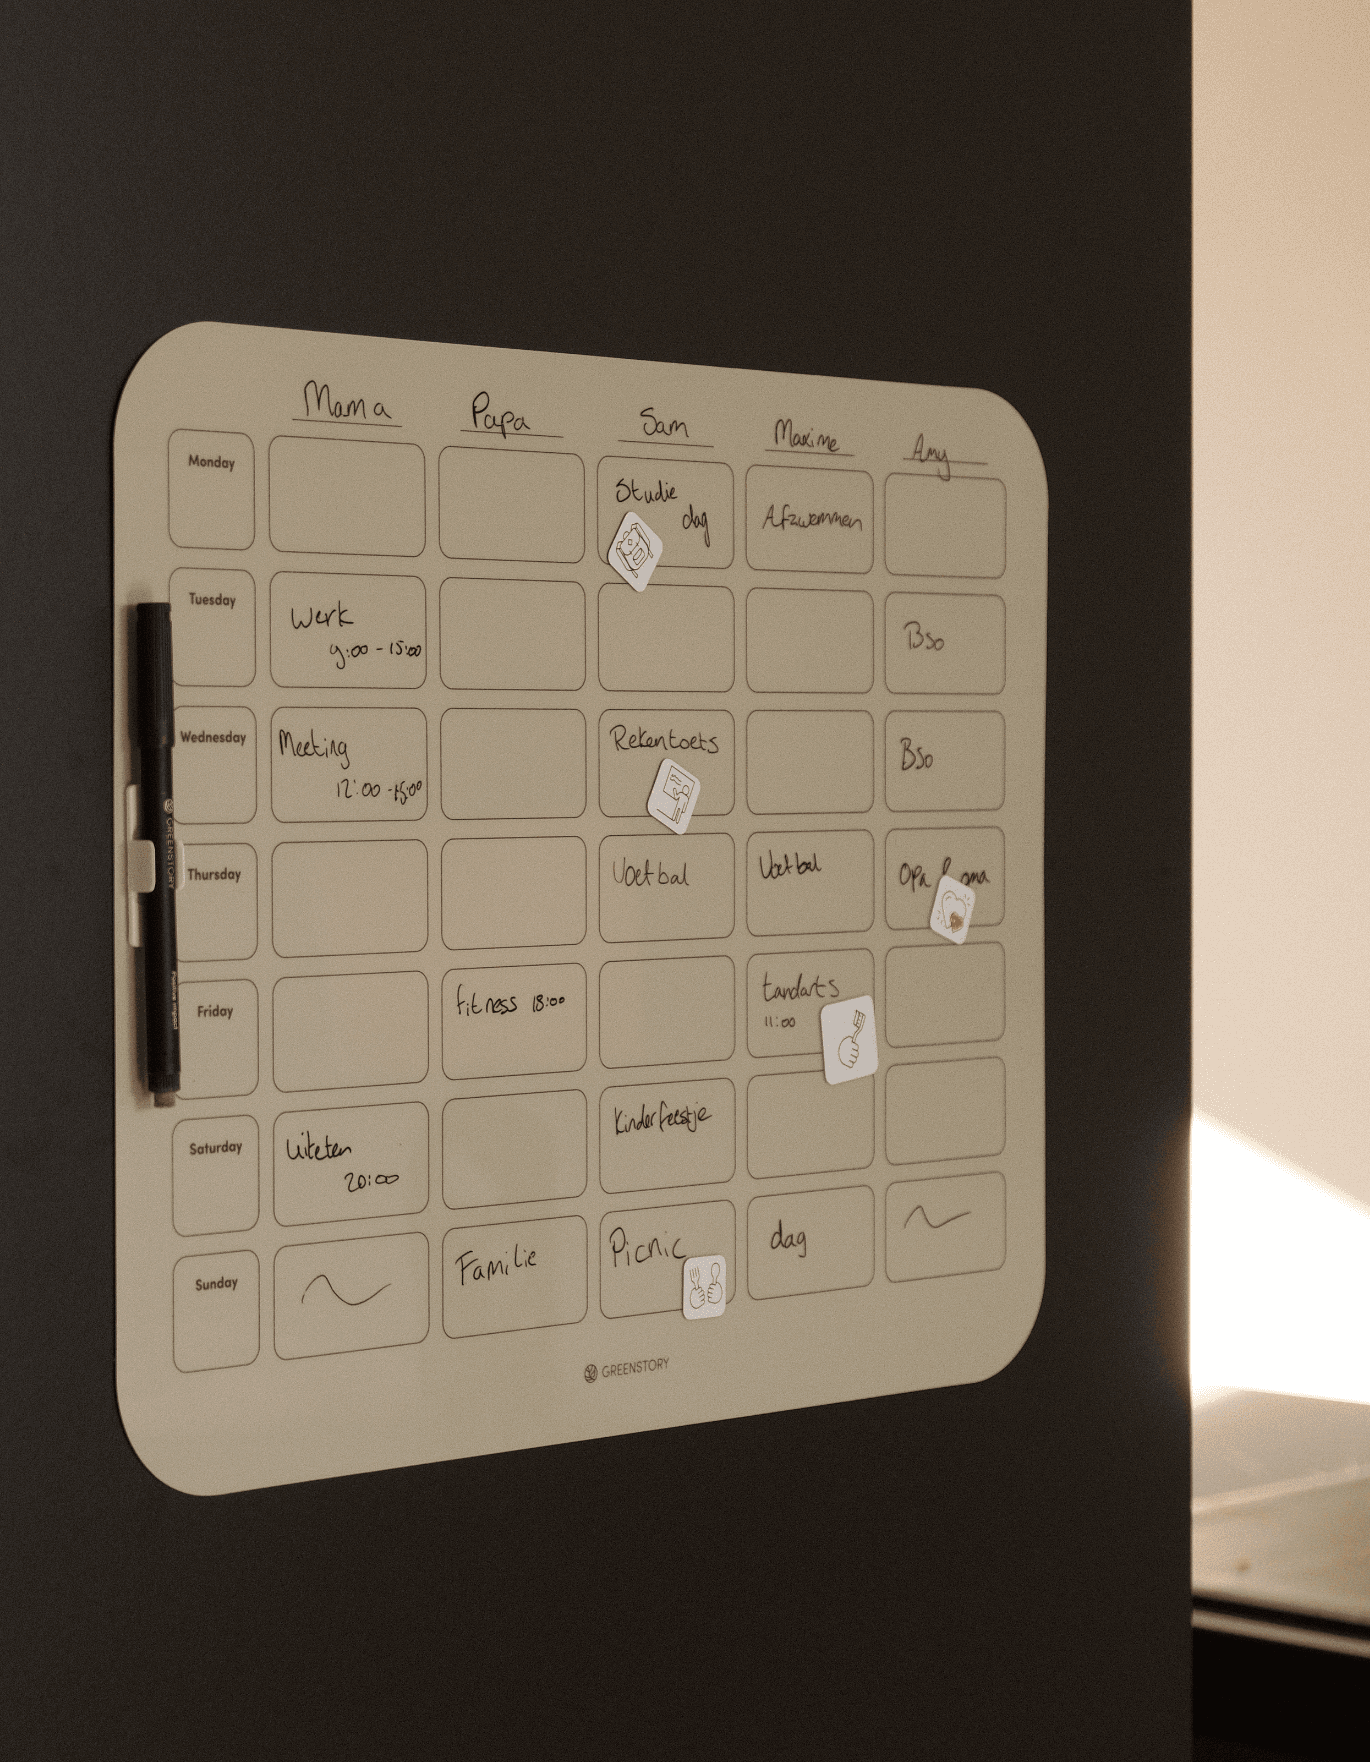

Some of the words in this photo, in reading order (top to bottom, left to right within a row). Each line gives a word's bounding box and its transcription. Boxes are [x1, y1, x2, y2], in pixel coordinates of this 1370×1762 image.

[303, 378, 392, 420] Mama
[471, 390, 530, 439] Papa
[639, 406, 690, 438] Sam
[774, 418, 841, 452] Maxime
[188, 454, 236, 473] Monday
[911, 432, 951, 483] Amy
[615, 477, 678, 505] Studie
[681, 503, 711, 548] dag
[188, 591, 237, 610] Tuesday
[290, 600, 355, 630] Werk
[389, 639, 423, 658] 15:00
[179, 730, 247, 747] Wednesday
[278, 728, 351, 771] Meeting
[336, 778, 381, 800] 12:00
[166, 817, 175, 890] GREENSTORY
[187, 867, 242, 884] Thursday
[762, 972, 840, 1003] tandarts
[197, 1004, 234, 1020] Friday
[531, 993, 566, 1013] 18:00
[764, 1016, 796, 1029] 11:00
[189, 1140, 243, 1156] Saturday
[343, 1171, 400, 1194] 20:00
[609, 1226, 687, 1268] Picnic
[770, 1219, 807, 1259] dag
[195, 1276, 239, 1292] Sunday
[601, 1357, 670, 1379] GREENSTORY
